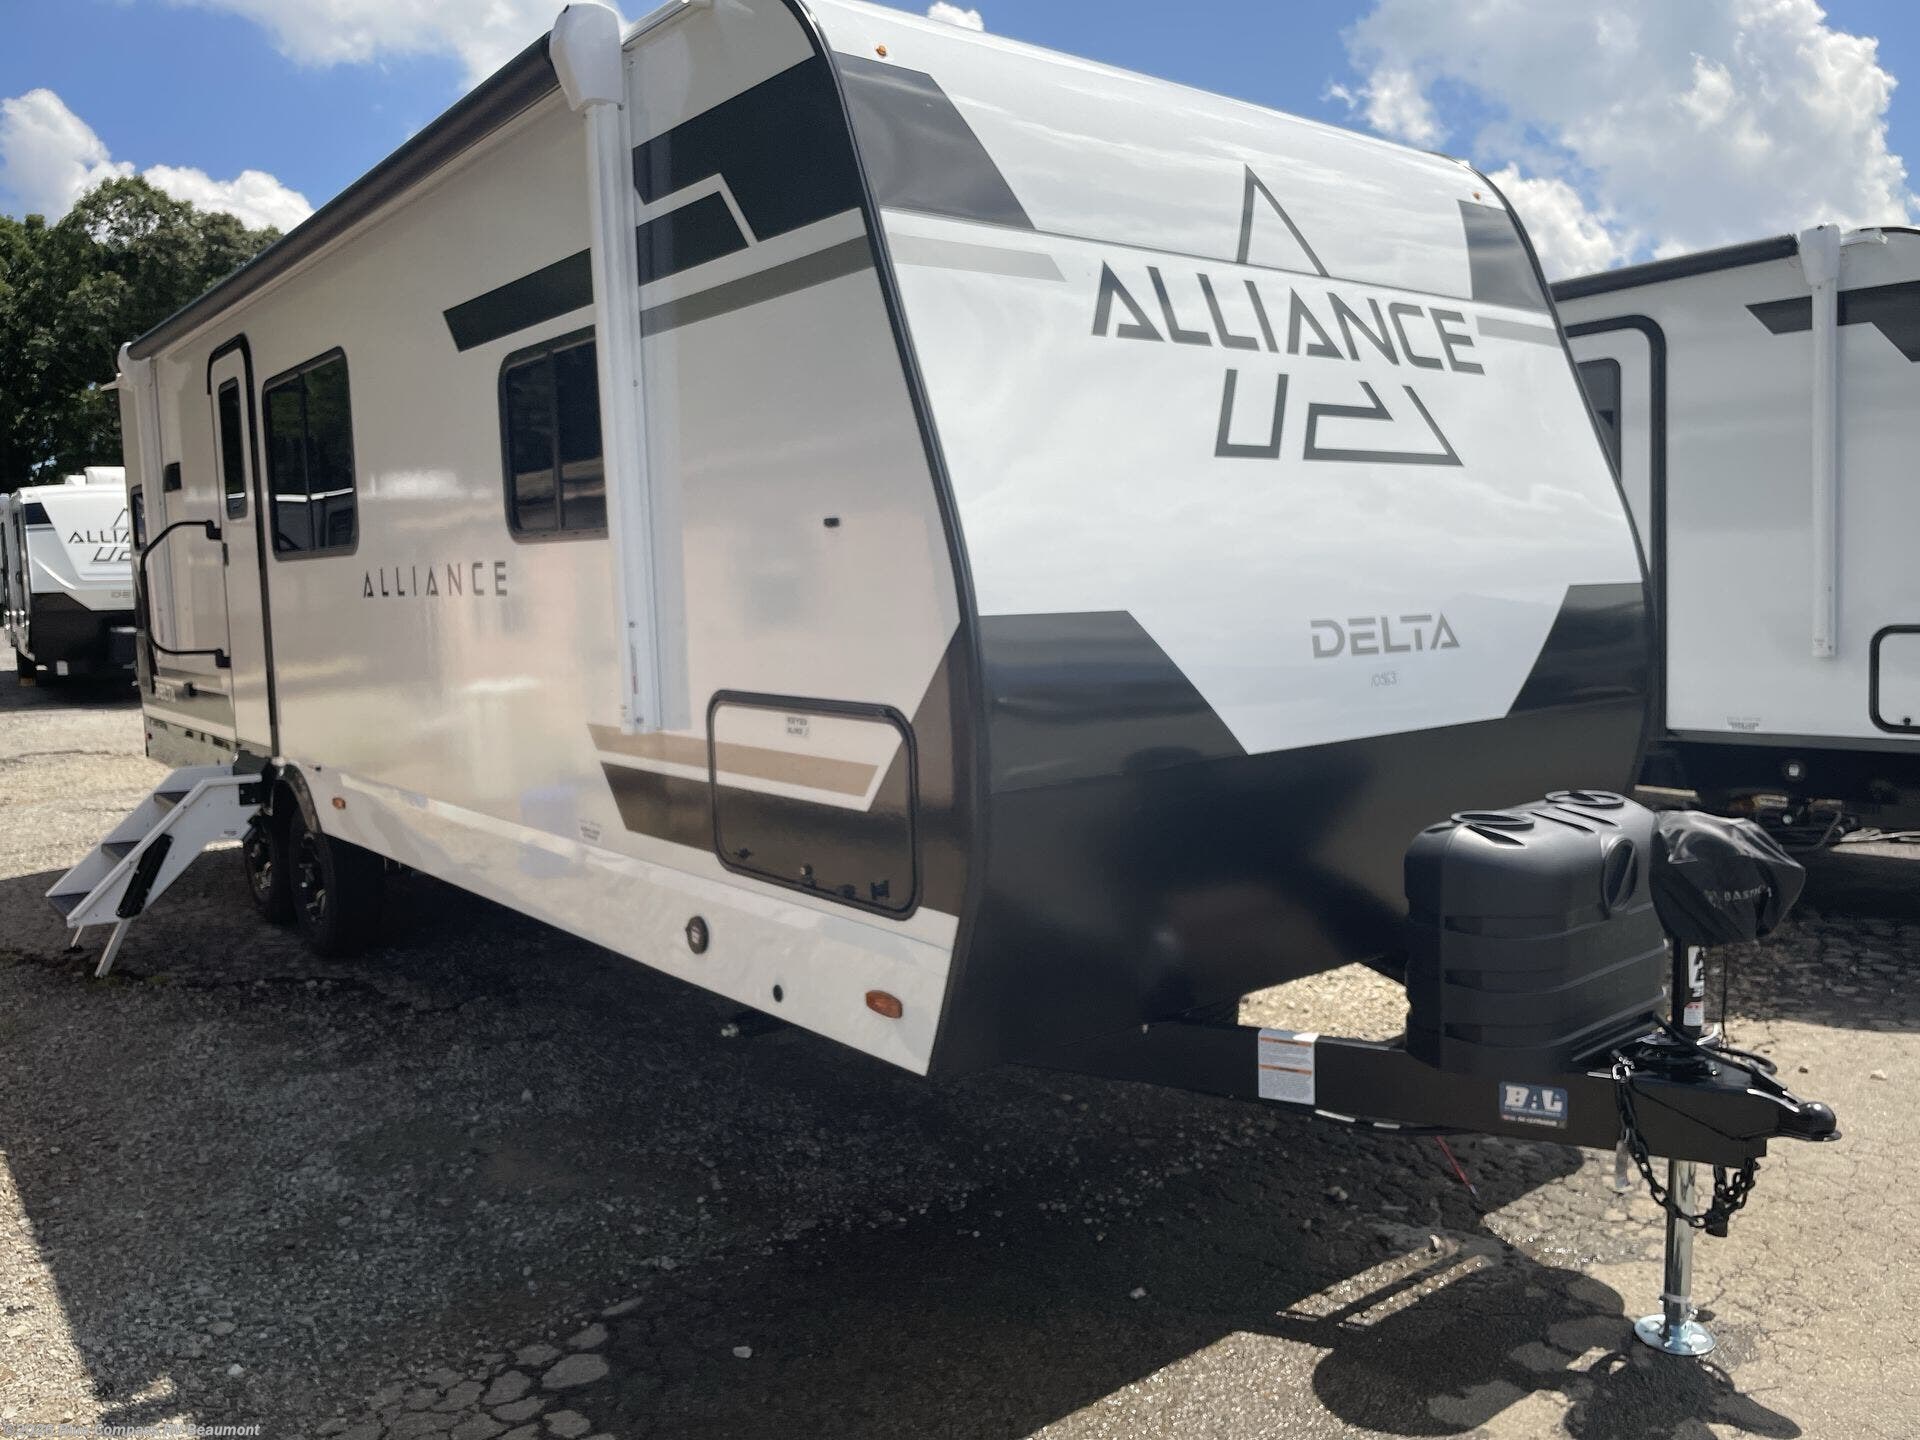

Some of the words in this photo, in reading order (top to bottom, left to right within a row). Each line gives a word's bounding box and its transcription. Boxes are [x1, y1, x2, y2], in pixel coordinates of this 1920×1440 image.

[1092, 260, 1485, 375] ALLIANCE
[68, 530, 130, 543] ALLIA
[363, 561, 508, 598] ALLIANCE
[1310, 612, 1460, 659] DELTA
